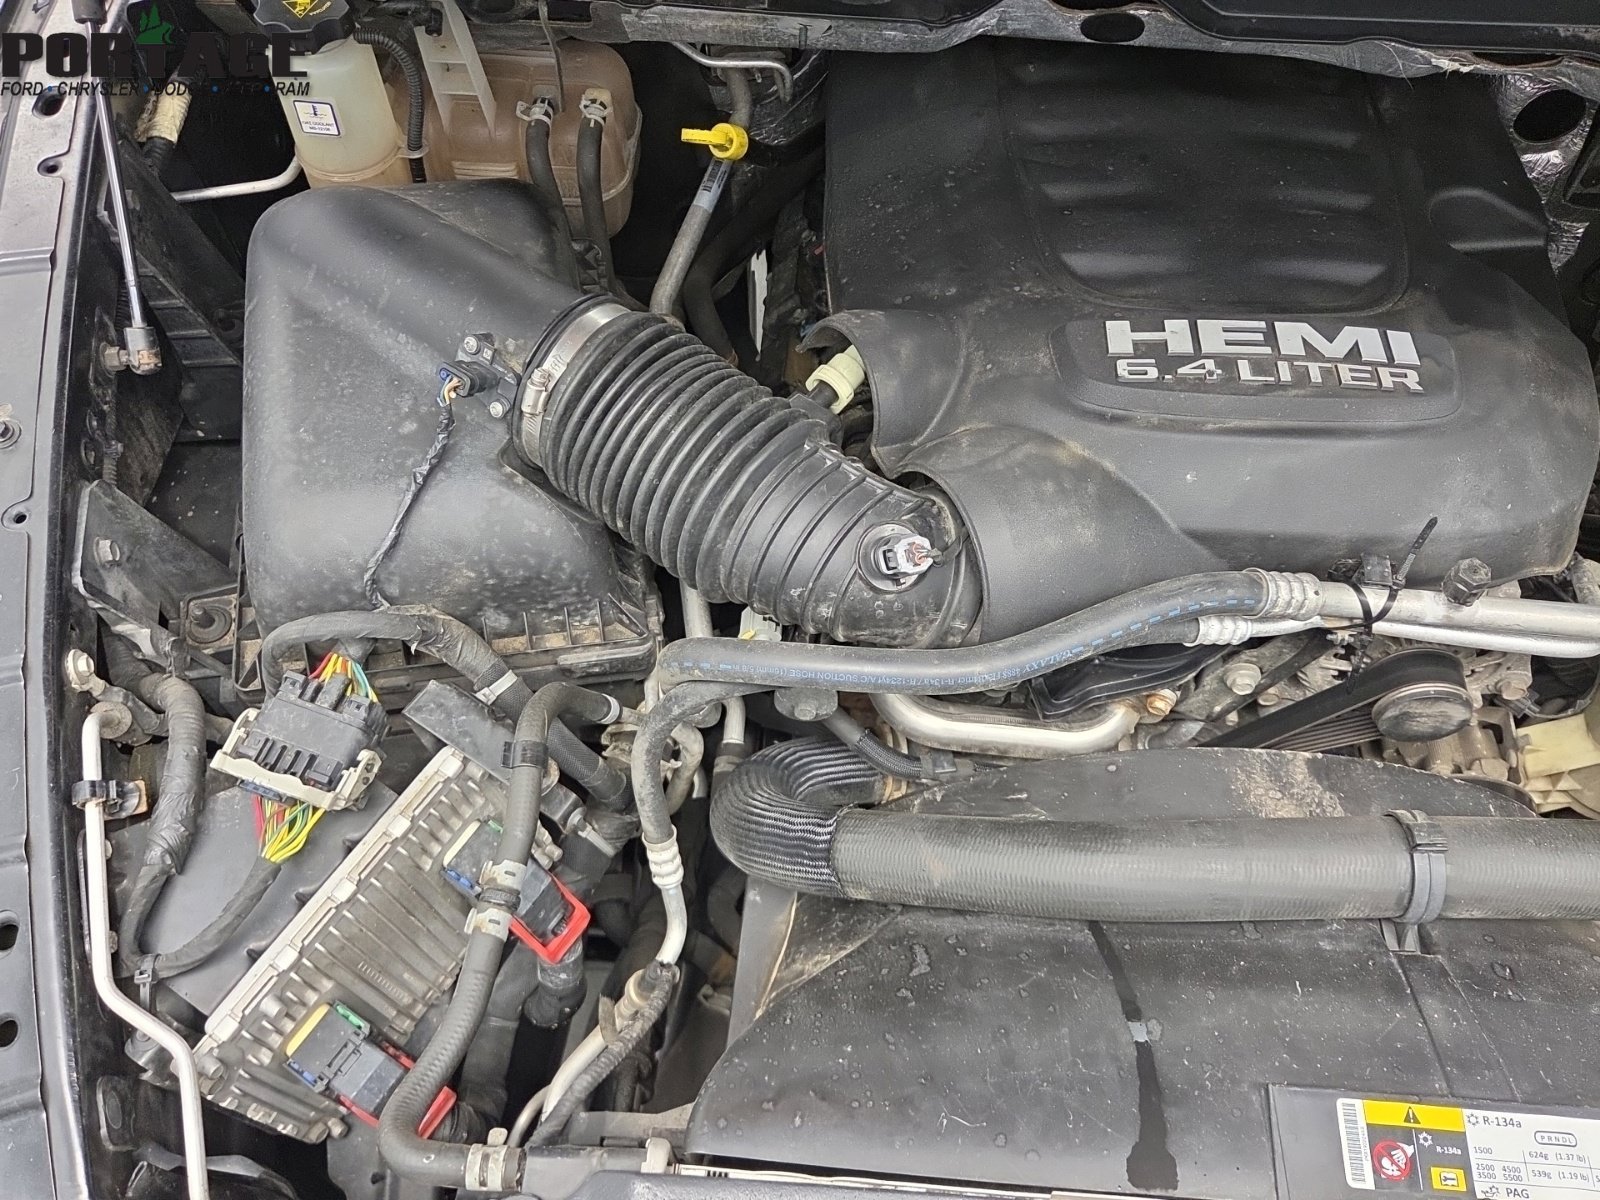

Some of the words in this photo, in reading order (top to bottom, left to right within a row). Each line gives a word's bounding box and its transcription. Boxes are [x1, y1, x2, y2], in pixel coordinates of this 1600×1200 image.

[1105, 319, 1421, 367] HEMI
[1116, 358, 1222, 384] 6.4
[1236, 359, 1425, 394] LITER
[1023, 649, 1074, 674] GALAXY
[789, 669, 815, 680] HOSE
[817, 671, 859, 683] SUCTION
[1482, 1115, 1522, 1129] R-134a
[1436, 1145, 1462, 1156] R-134a
[1473, 1146, 1493, 1155] 1500
[1528, 1151, 1549, 1161] 624g
[1475, 1162, 1495, 1172] 2500
[1502, 1165, 1521, 1174] 4500
[1477, 1171, 1497, 1180] 3500
[1503, 1173, 1523, 1182] 5500
[1531, 1169, 1552, 1180] 539g
[1506, 1187, 1530, 1199] PAG
